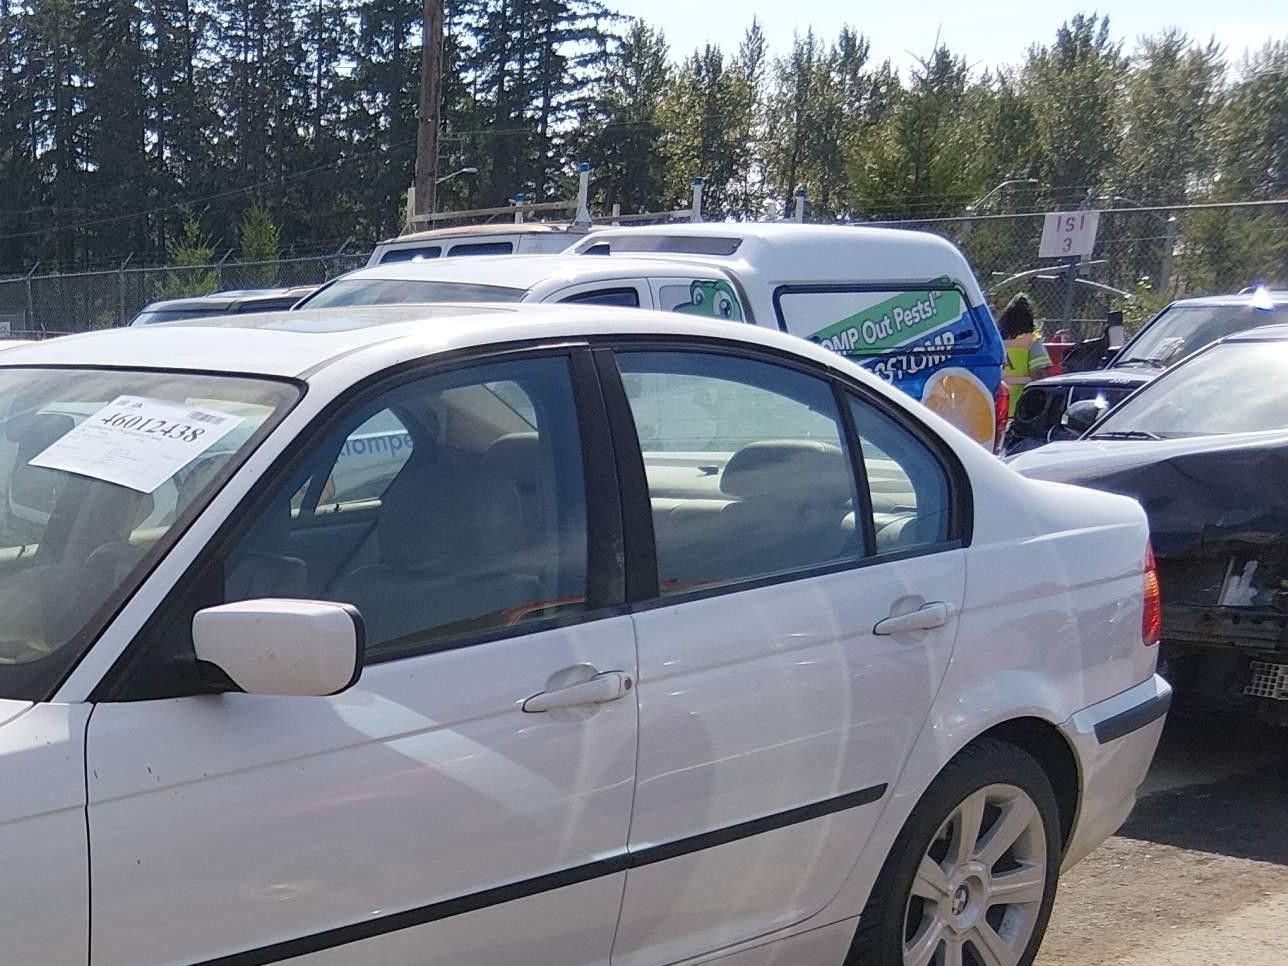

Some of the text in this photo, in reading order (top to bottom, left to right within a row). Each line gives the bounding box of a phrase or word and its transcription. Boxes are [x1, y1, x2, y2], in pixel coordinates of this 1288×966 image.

[1062, 238, 1072, 253] 3
[821, 327, 859, 356] OMP
[862, 315, 893, 344] Out
[101, 412, 206, 443] 46012438
